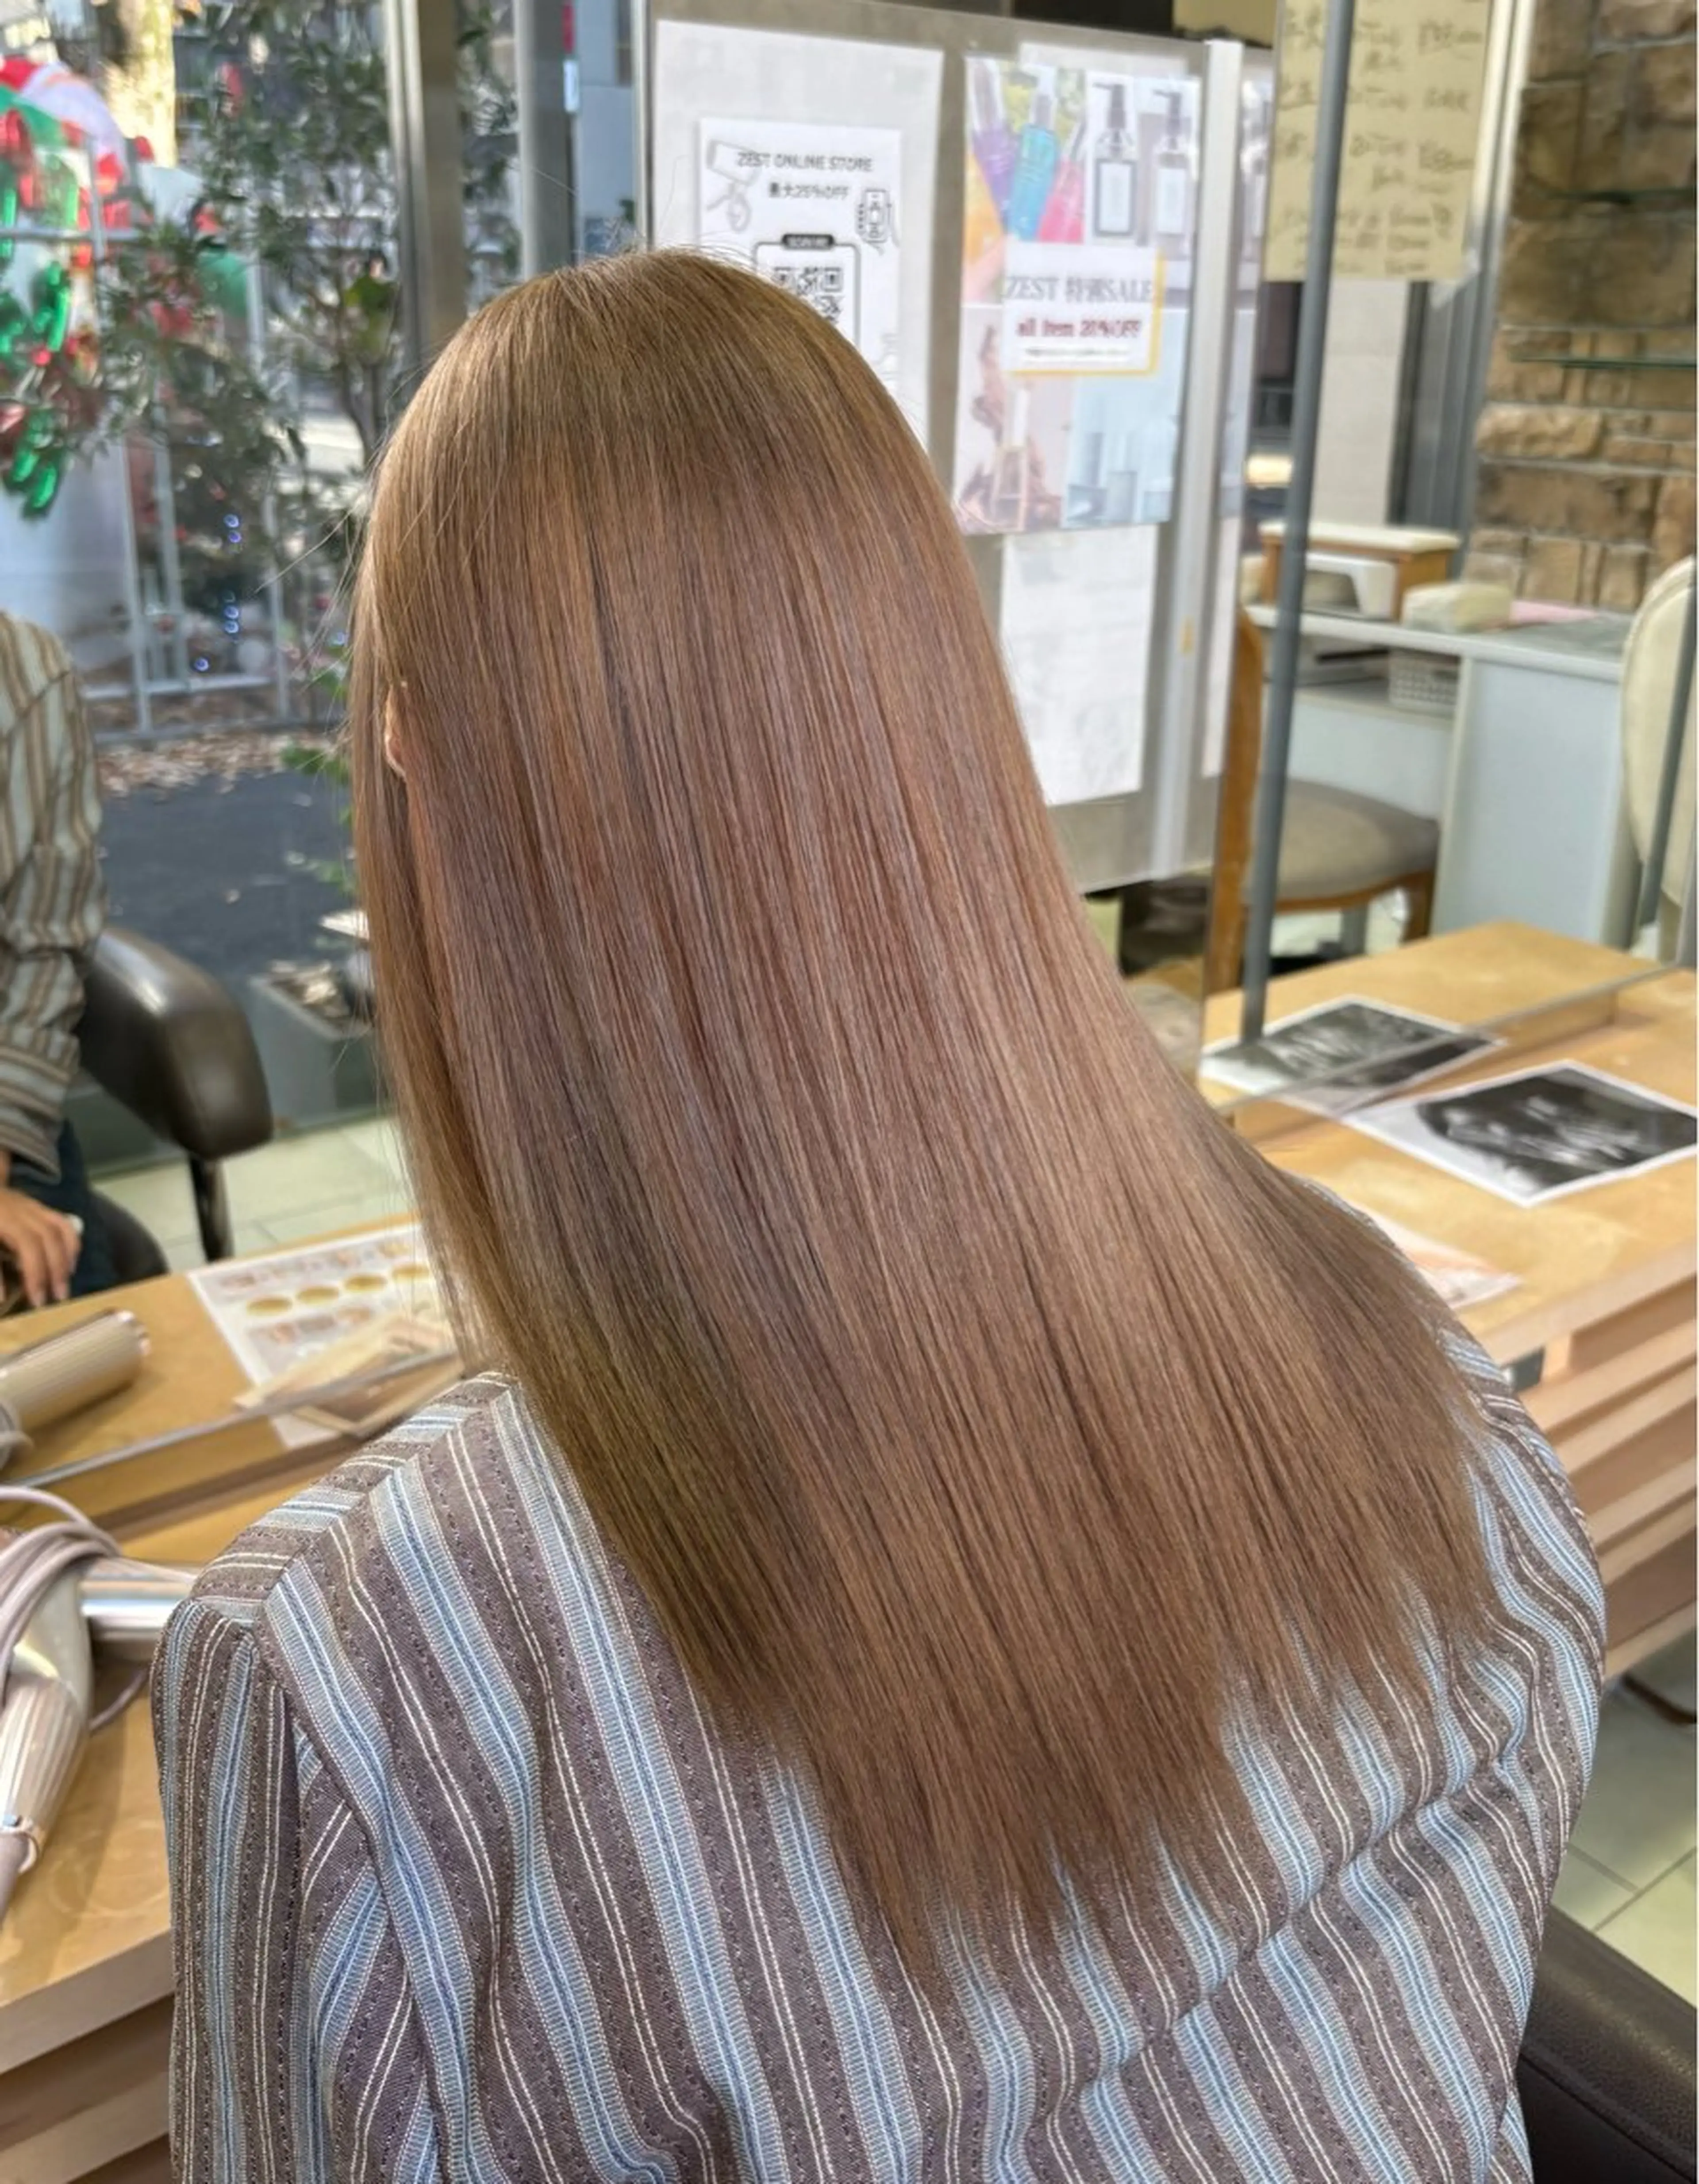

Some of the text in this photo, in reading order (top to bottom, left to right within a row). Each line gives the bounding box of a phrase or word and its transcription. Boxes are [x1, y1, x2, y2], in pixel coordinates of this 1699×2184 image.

[774, 154, 825, 169] ONLINE
[828, 156, 872, 172] STORE
[1003, 276, 1059, 301] ZEST
